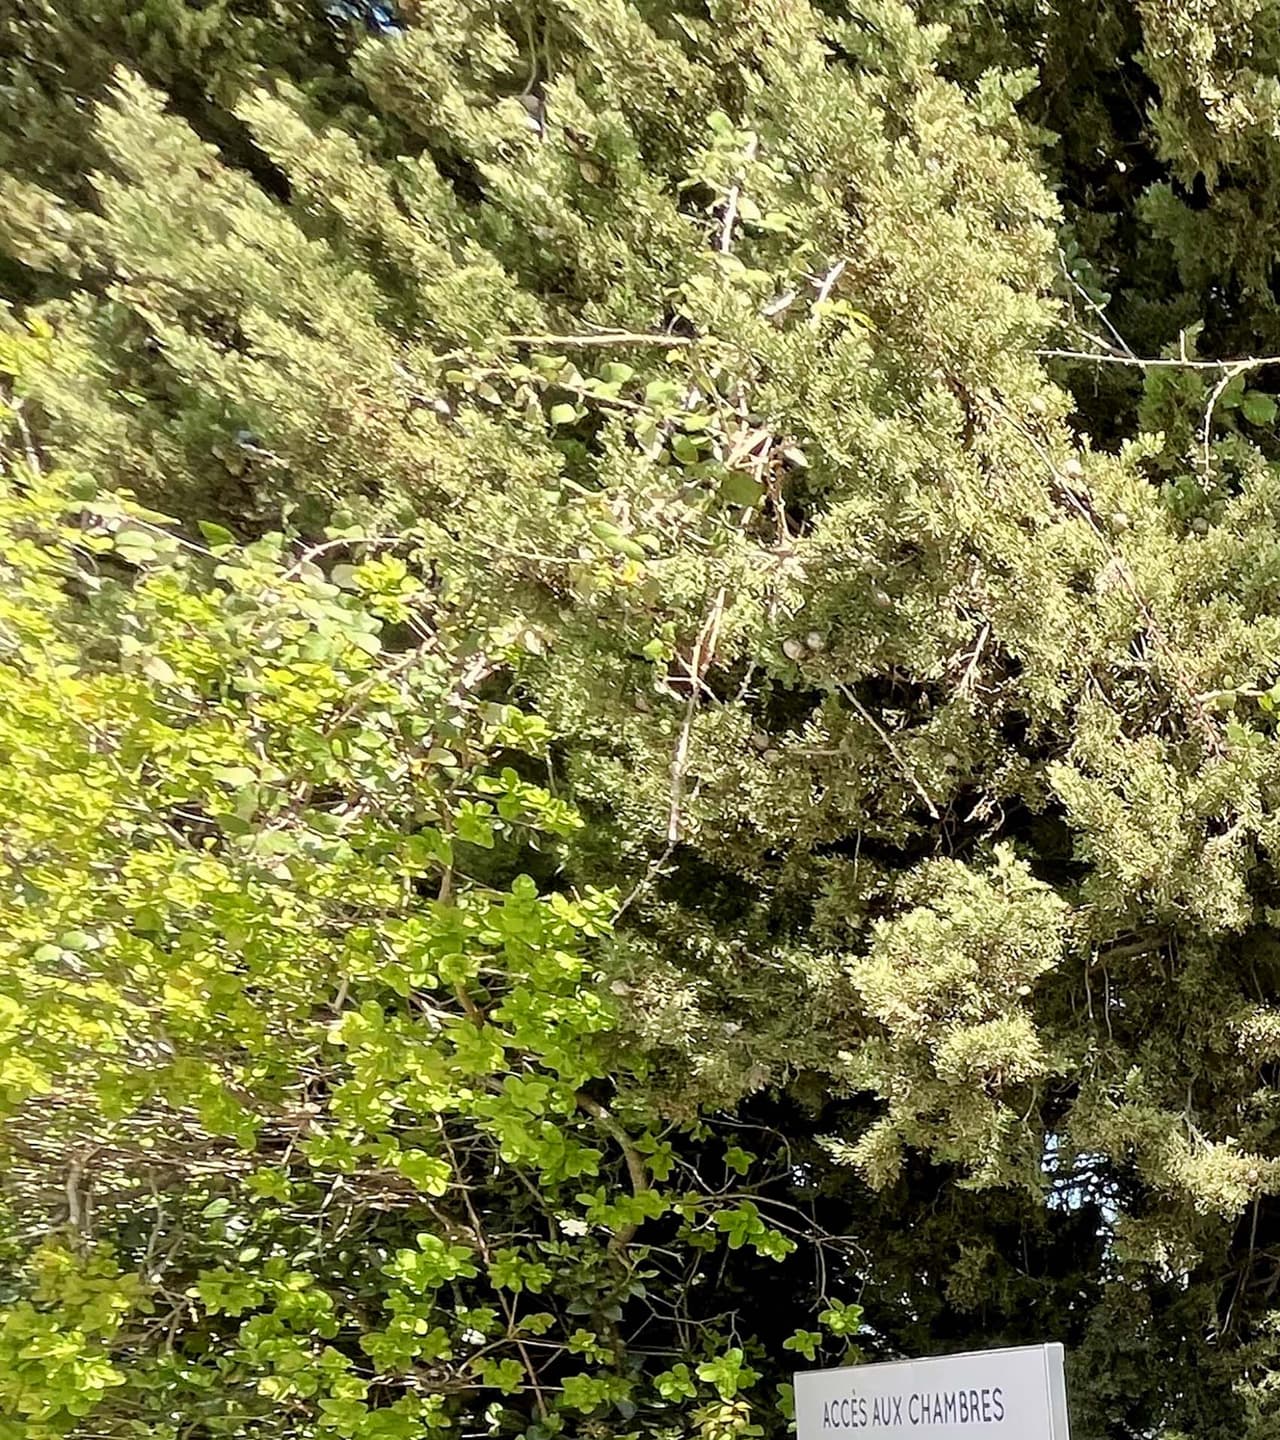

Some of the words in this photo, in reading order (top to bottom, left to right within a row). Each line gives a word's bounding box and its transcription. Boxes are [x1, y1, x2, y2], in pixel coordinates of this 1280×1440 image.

[823, 1388, 868, 1429] ACCÈS
[873, 1396, 902, 1426] AUX
[908, 1387, 1005, 1425] CHAMBRES
